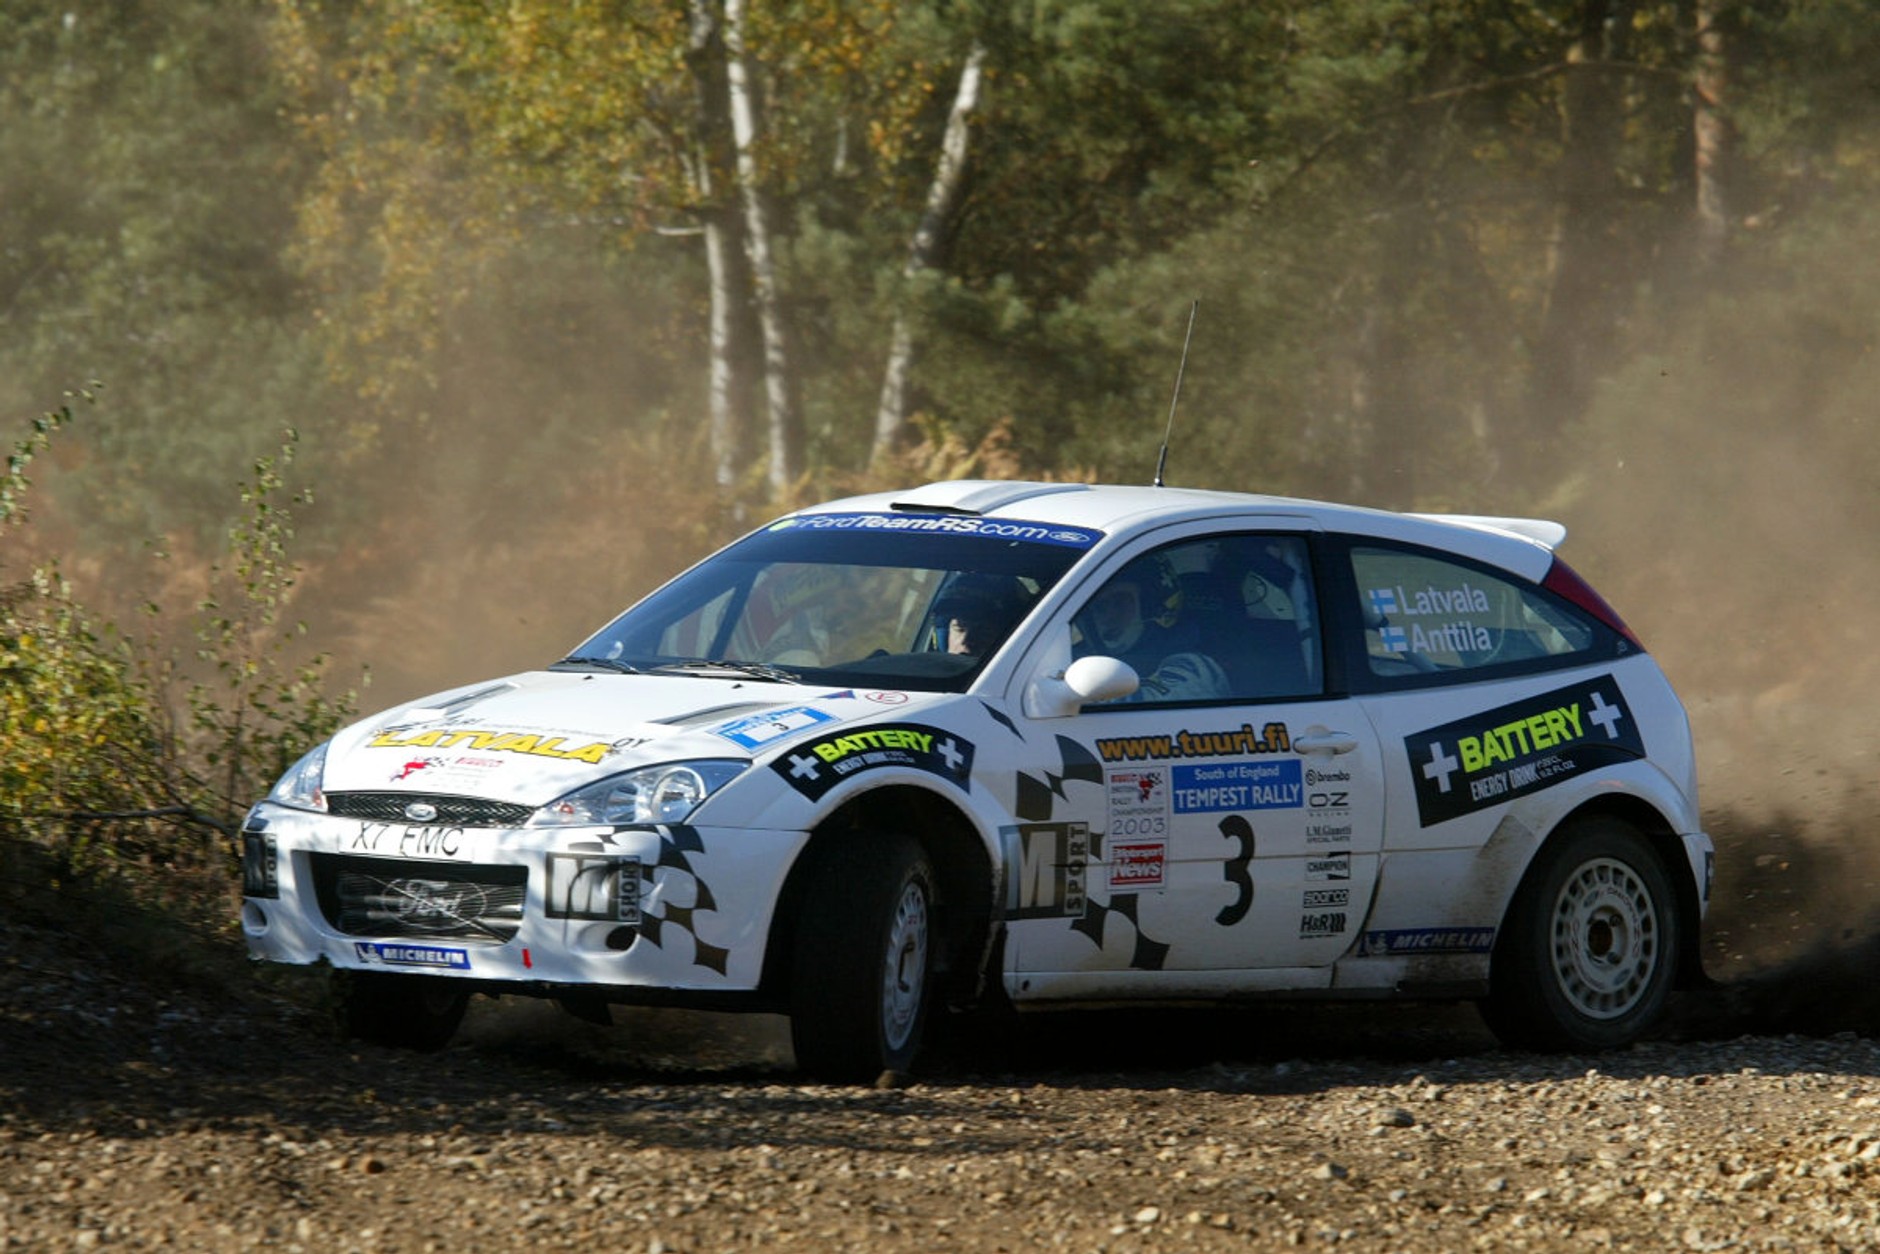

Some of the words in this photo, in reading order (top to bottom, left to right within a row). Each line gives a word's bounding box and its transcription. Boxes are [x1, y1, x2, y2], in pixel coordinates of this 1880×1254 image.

[1397, 583, 1489, 615] Latvala
[1412, 621, 1493, 653] Anttila
[367, 728, 614, 765] LATVALA
[812, 729, 934, 763] BATTERY
[1096, 722, 1291, 763] www.tuuri.fi
[1458, 702, 1584, 774] BATTERY
[1194, 767, 1225, 781] South
[1226, 766, 1239, 779] of
[1239, 763, 1281, 781] England
[1470, 771, 1509, 801] ENERGY
[1175, 786, 1249, 809] TEMPEST
[1251, 783, 1300, 805] RALLY
[1308, 792, 1349, 808] OZ
[353, 822, 389, 850] X7
[400, 825, 464, 857] FMC
[1112, 817, 1166, 836] 2003
[1066, 825, 1086, 911] SPORT
[1113, 858, 1162, 879] News
[1214, 814, 1256, 927] 3
[381, 947, 465, 964] MICHELIN
[1391, 931, 1493, 949] MICHELIN
